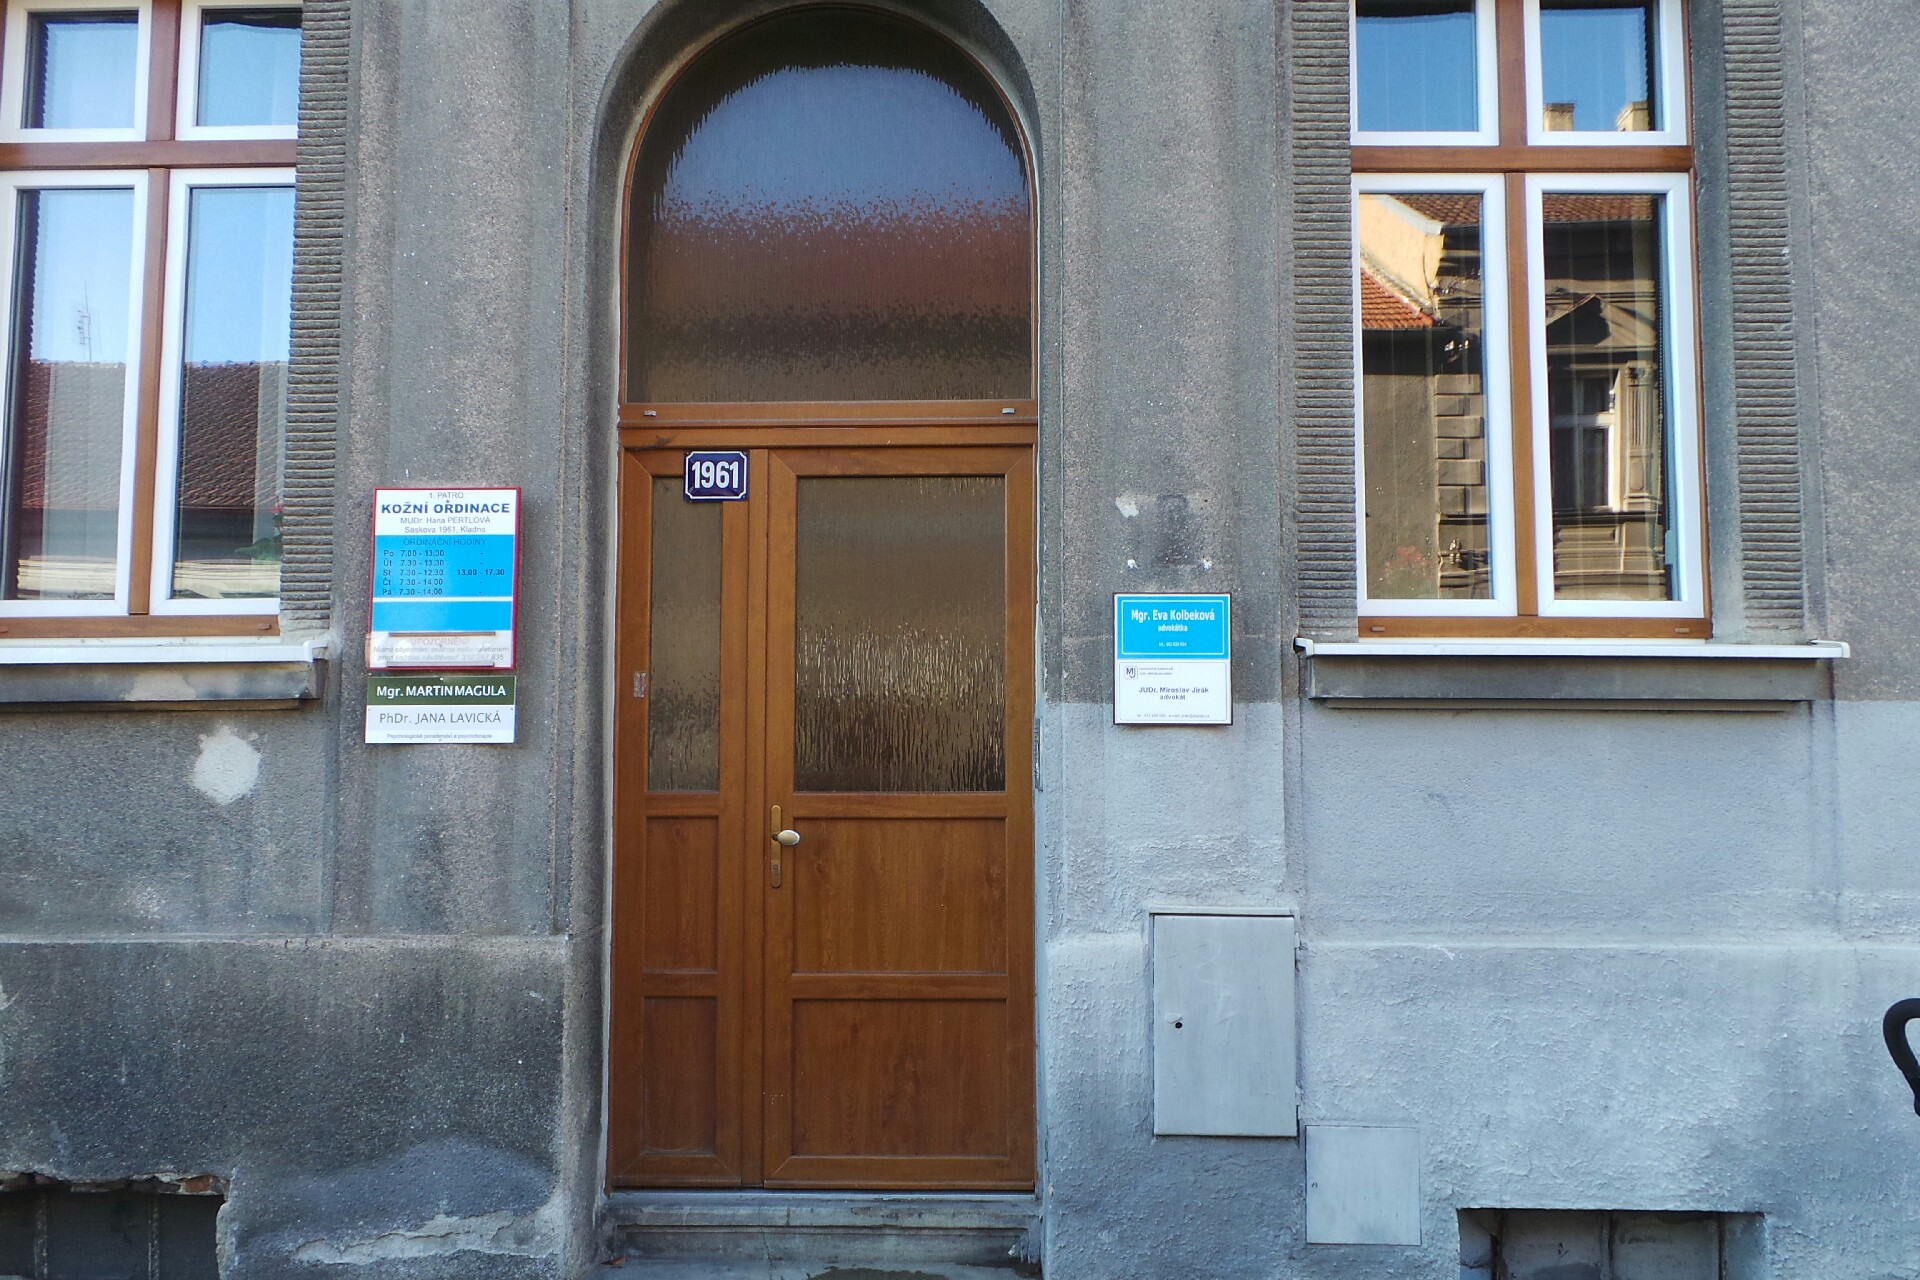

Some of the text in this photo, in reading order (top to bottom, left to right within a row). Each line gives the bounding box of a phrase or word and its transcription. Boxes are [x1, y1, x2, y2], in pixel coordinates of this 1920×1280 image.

[692, 461, 738, 488] 1961
[381, 502, 510, 514] KOŽNÍ ORDINACE
[448, 515, 490, 524] PERTLOVÁ
[404, 537, 451, 546] ORDINAČNÍ
[384, 558, 392, 566] Út
[382, 577, 391, 585] Čt
[1131, 608, 1215, 623] Mgr. Eva Kolbeková
[1158, 623, 1188, 632] advokátka
[376, 685, 506, 699] Mgr. MARTIN MAGULA
[380, 710, 501, 724] PhDr. JANA LAVICKÁ
